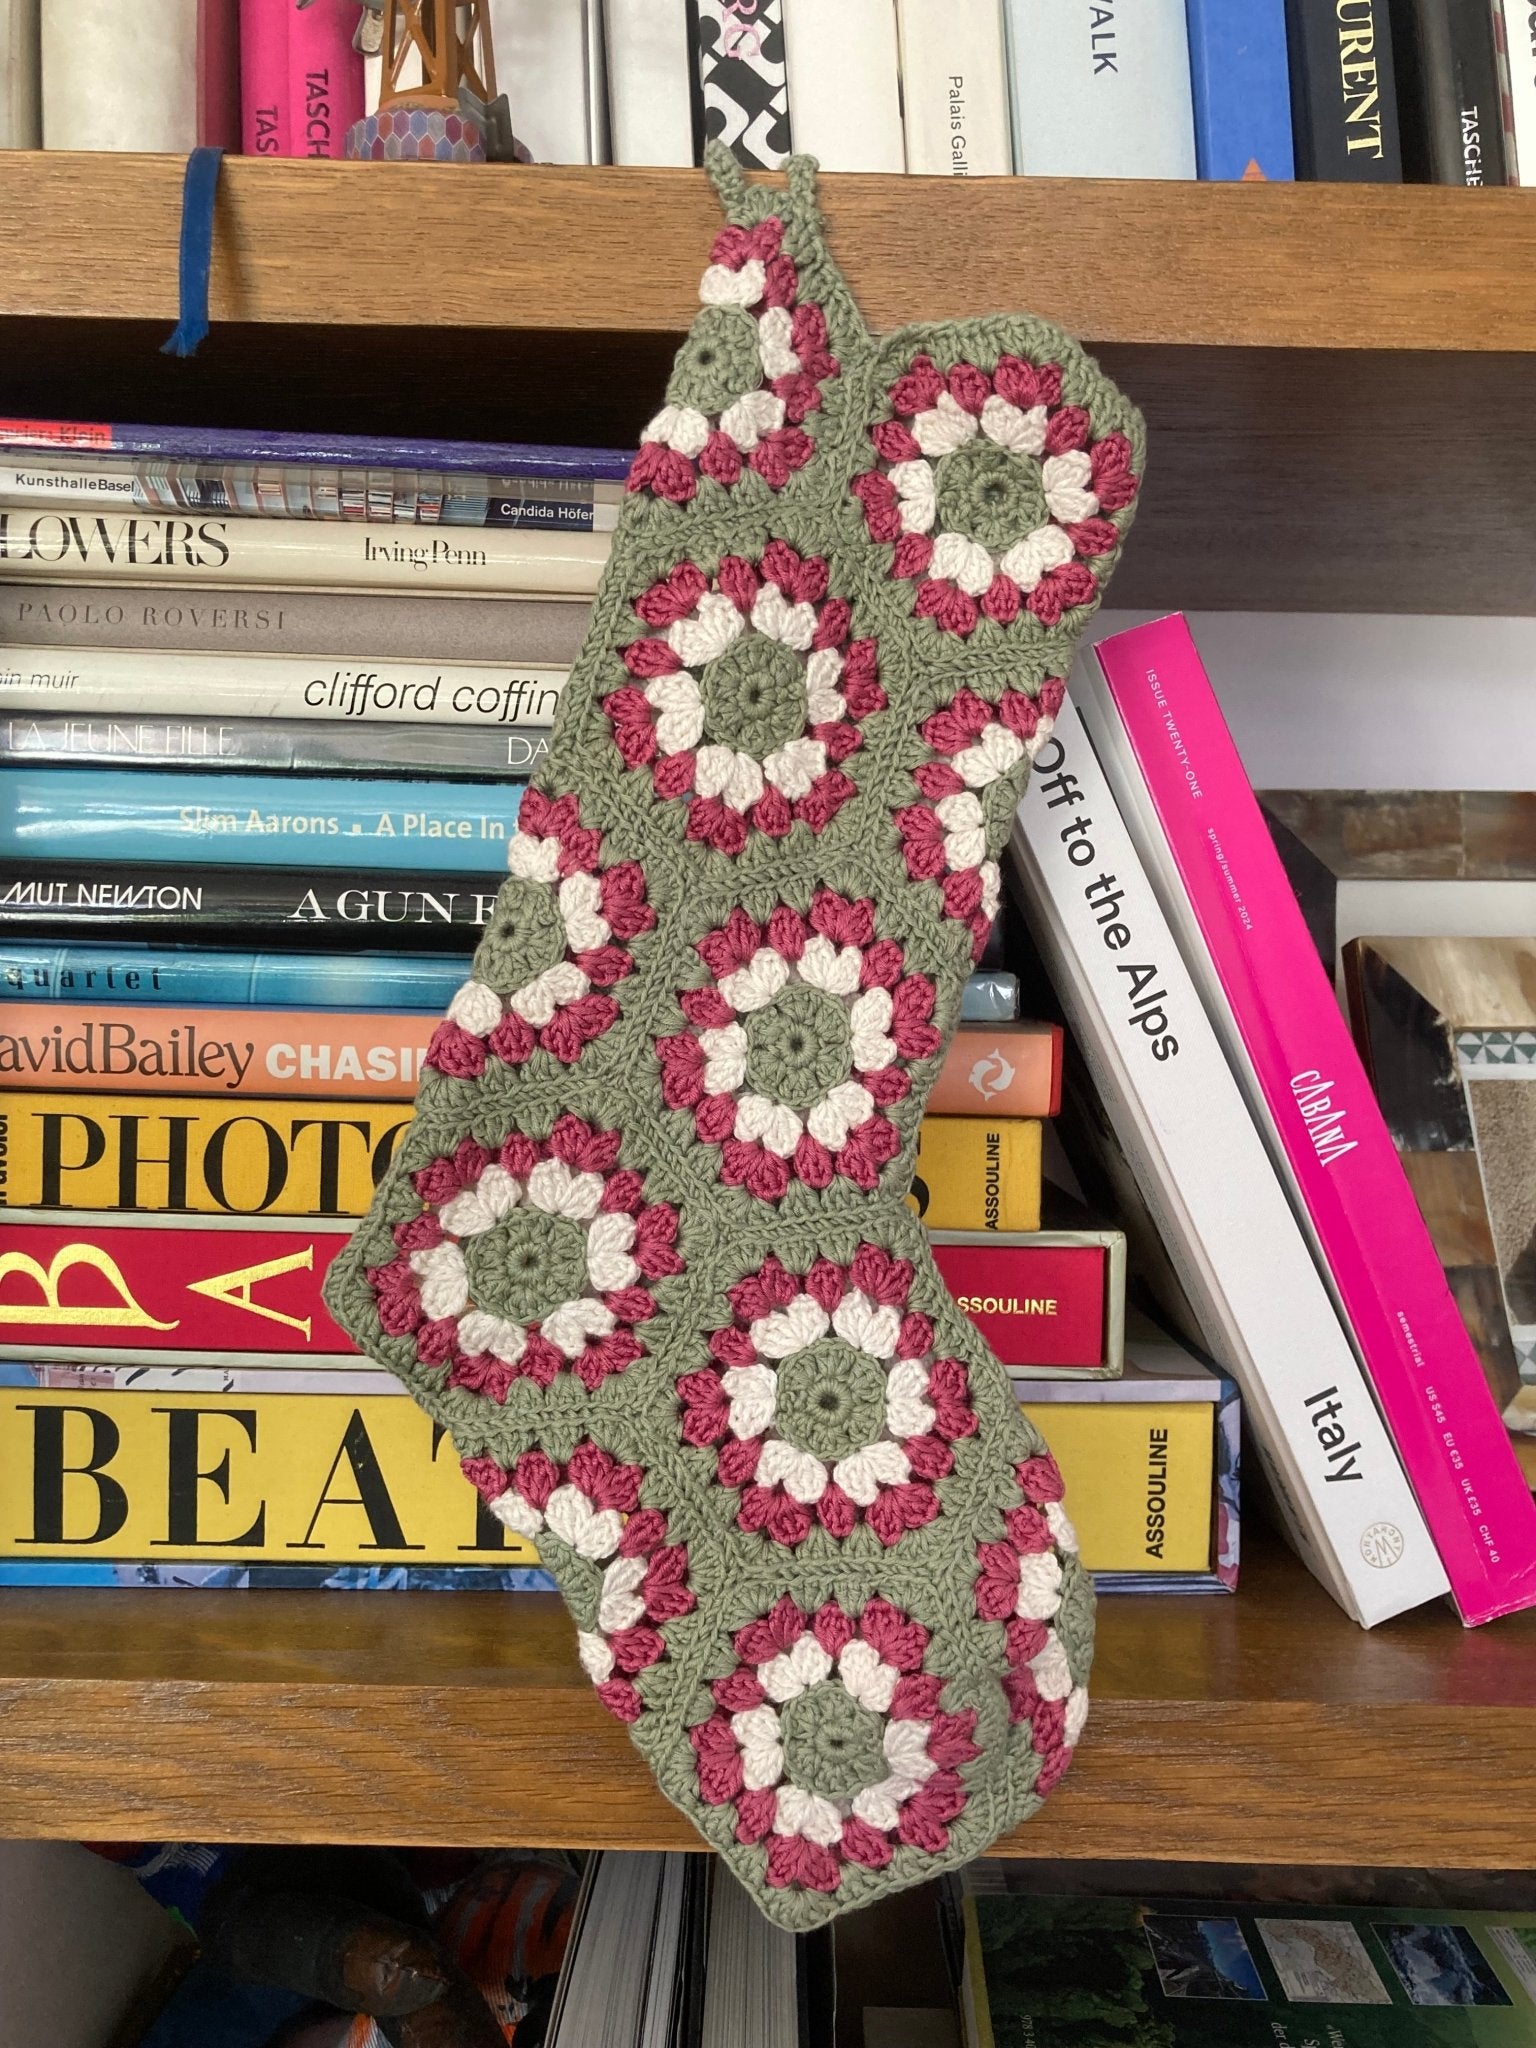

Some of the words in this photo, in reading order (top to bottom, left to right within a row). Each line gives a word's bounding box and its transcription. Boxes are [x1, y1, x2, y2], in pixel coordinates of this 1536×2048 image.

[1089, 0, 1118, 75] ALK
[949, 76, 965, 130] Palais
[501, 503, 554, 518] Candida
[558, 506, 594, 520] Höfer
[0, 513, 230, 567] LOWERS
[364, 537, 428, 571] Irving
[432, 540, 487, 565] Penn
[19, 603, 124, 627] PAOLO
[143, 607, 284, 630] ROVERSI
[31, 671, 79, 689] muir
[304, 672, 442, 715] clifford
[452, 680, 559, 722] coffin
[9, 722, 46, 751] LA
[54, 722, 156, 754] JEUNE
[166, 725, 236, 755] FILLE
[1146, 669, 1168, 707] ISSUE
[1162, 710, 1203, 800] TWENTY-ONE
[179, 807, 237, 833] Slim
[245, 809, 339, 835] Aarons
[376, 813, 397, 837] A
[403, 814, 472, 838] Place
[481, 817, 505, 839] In
[1208, 827, 1242, 905] spring/summer
[1237, 904, 1253, 931] 2024
[3, 882, 67, 905] MUT
[78, 884, 202, 910] NEWTON
[287, 889, 331, 920] A
[337, 890, 461, 923] GUN
[1033, 736, 1085, 809] Off
[1061, 816, 1095, 867] to
[1085, 873, 1131, 950] the
[1116, 964, 1179, 1062] Alps
[6, 964, 162, 991] quartet
[1290, 1070, 1359, 1168] CABANA
[985, 1132, 1000, 1231] ASSOULINE
[1397, 1311, 1425, 1368] semestrial
[1425, 1386, 1437, 1402] US
[1431, 1402, 1446, 1424] $45
[1304, 1385, 1363, 1483] Italy
[1443, 1431, 1456, 1448] EU
[1450, 1449, 1464, 1470] €35
[1145, 1428, 1168, 1560] ASSOULINE
[1461, 1478, 1474, 1495] UK
[1467, 1495, 1482, 1517] £35
[1479, 1525, 1495, 1547] CHF
[1489, 1547, 1500, 1564] 40
